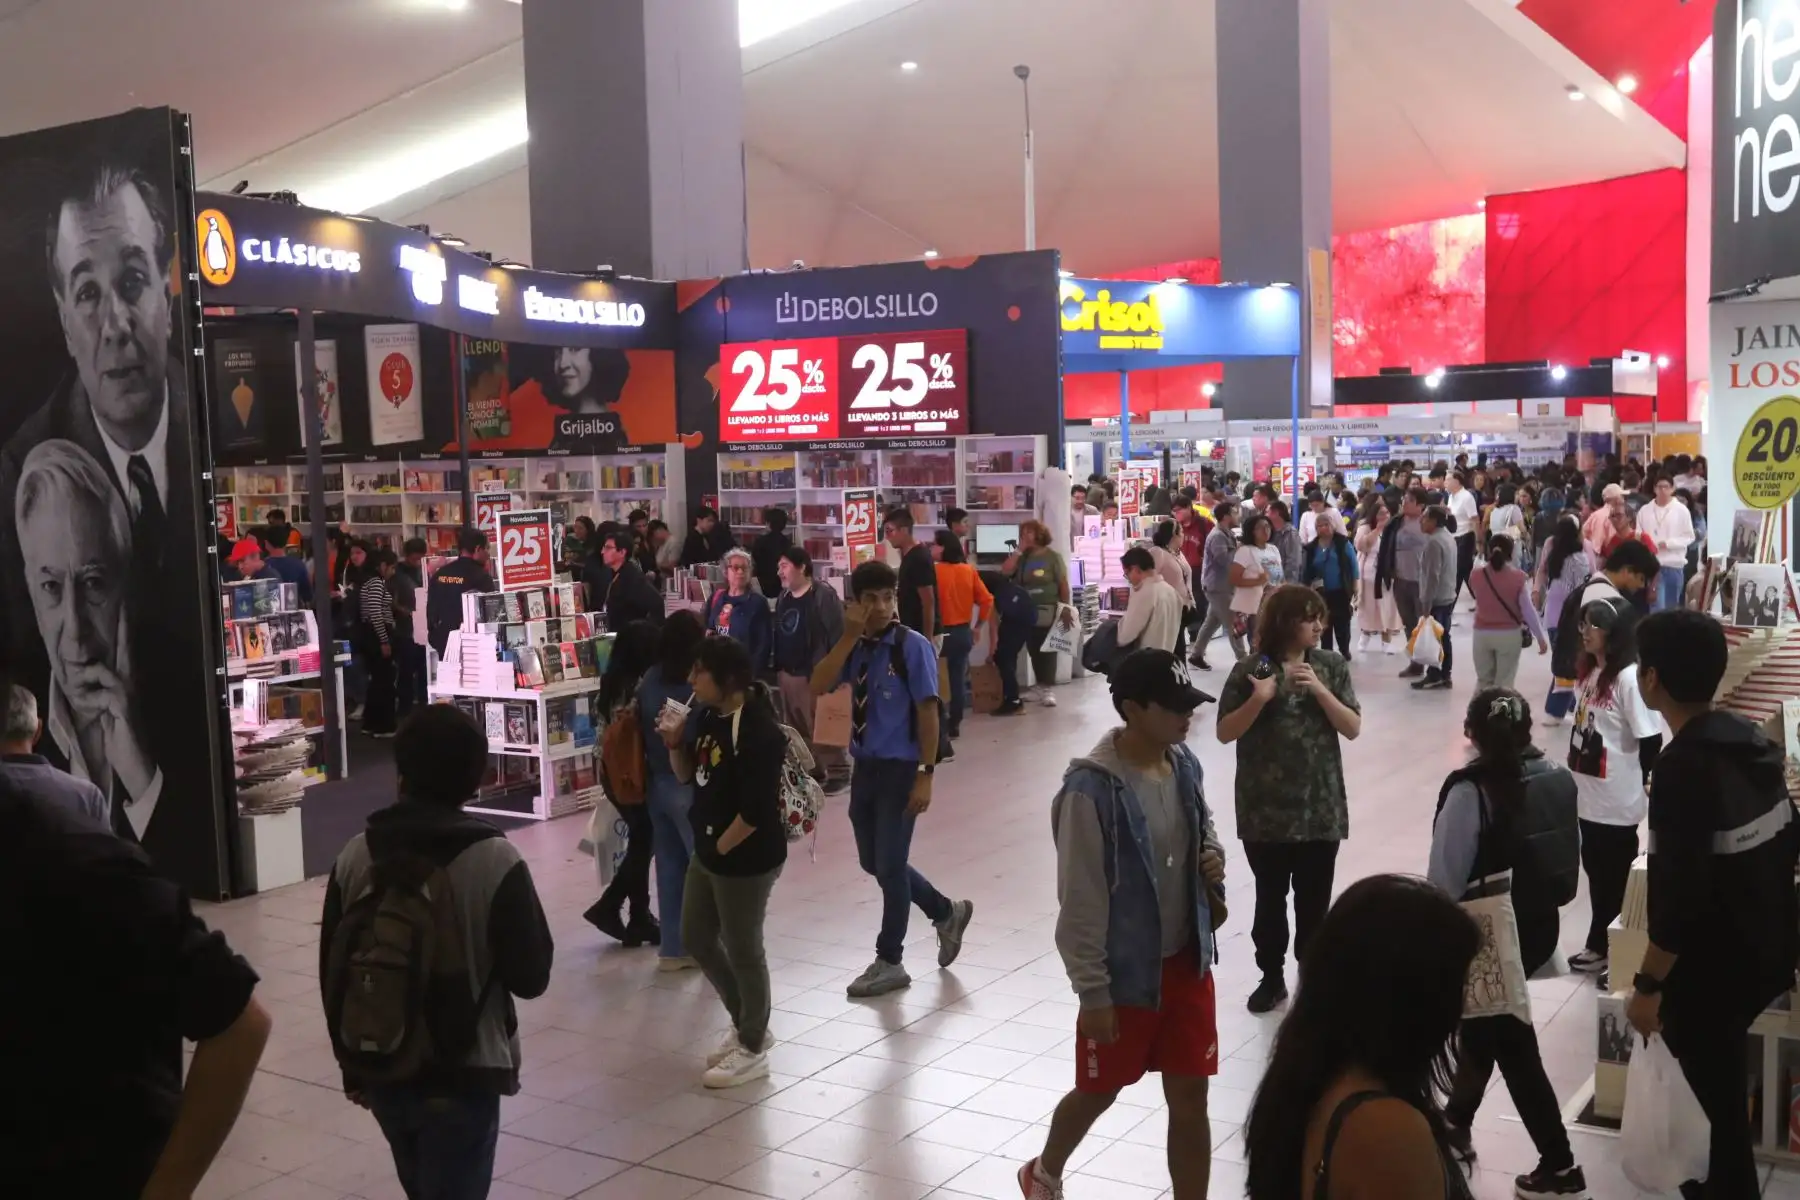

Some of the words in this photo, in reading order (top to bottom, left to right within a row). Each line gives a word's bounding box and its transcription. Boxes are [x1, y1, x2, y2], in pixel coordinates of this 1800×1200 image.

[242, 238, 361, 272] CLÁSICOS
[1060, 285, 1164, 332] Crisol
[391, 370, 401, 389] 5
[848, 412, 890, 421] LLEVANDO
[892, 412, 898, 420] 3
[899, 411, 928, 420] LIBROS
[930, 411, 938, 419] O
[940, 408, 959, 419] MÁS
[560, 418, 615, 438] Grijalbo
[888, 440, 907, 448] Libros
[1742, 471, 1795, 481] DESCUENTO
[216, 505, 228, 528] 5
